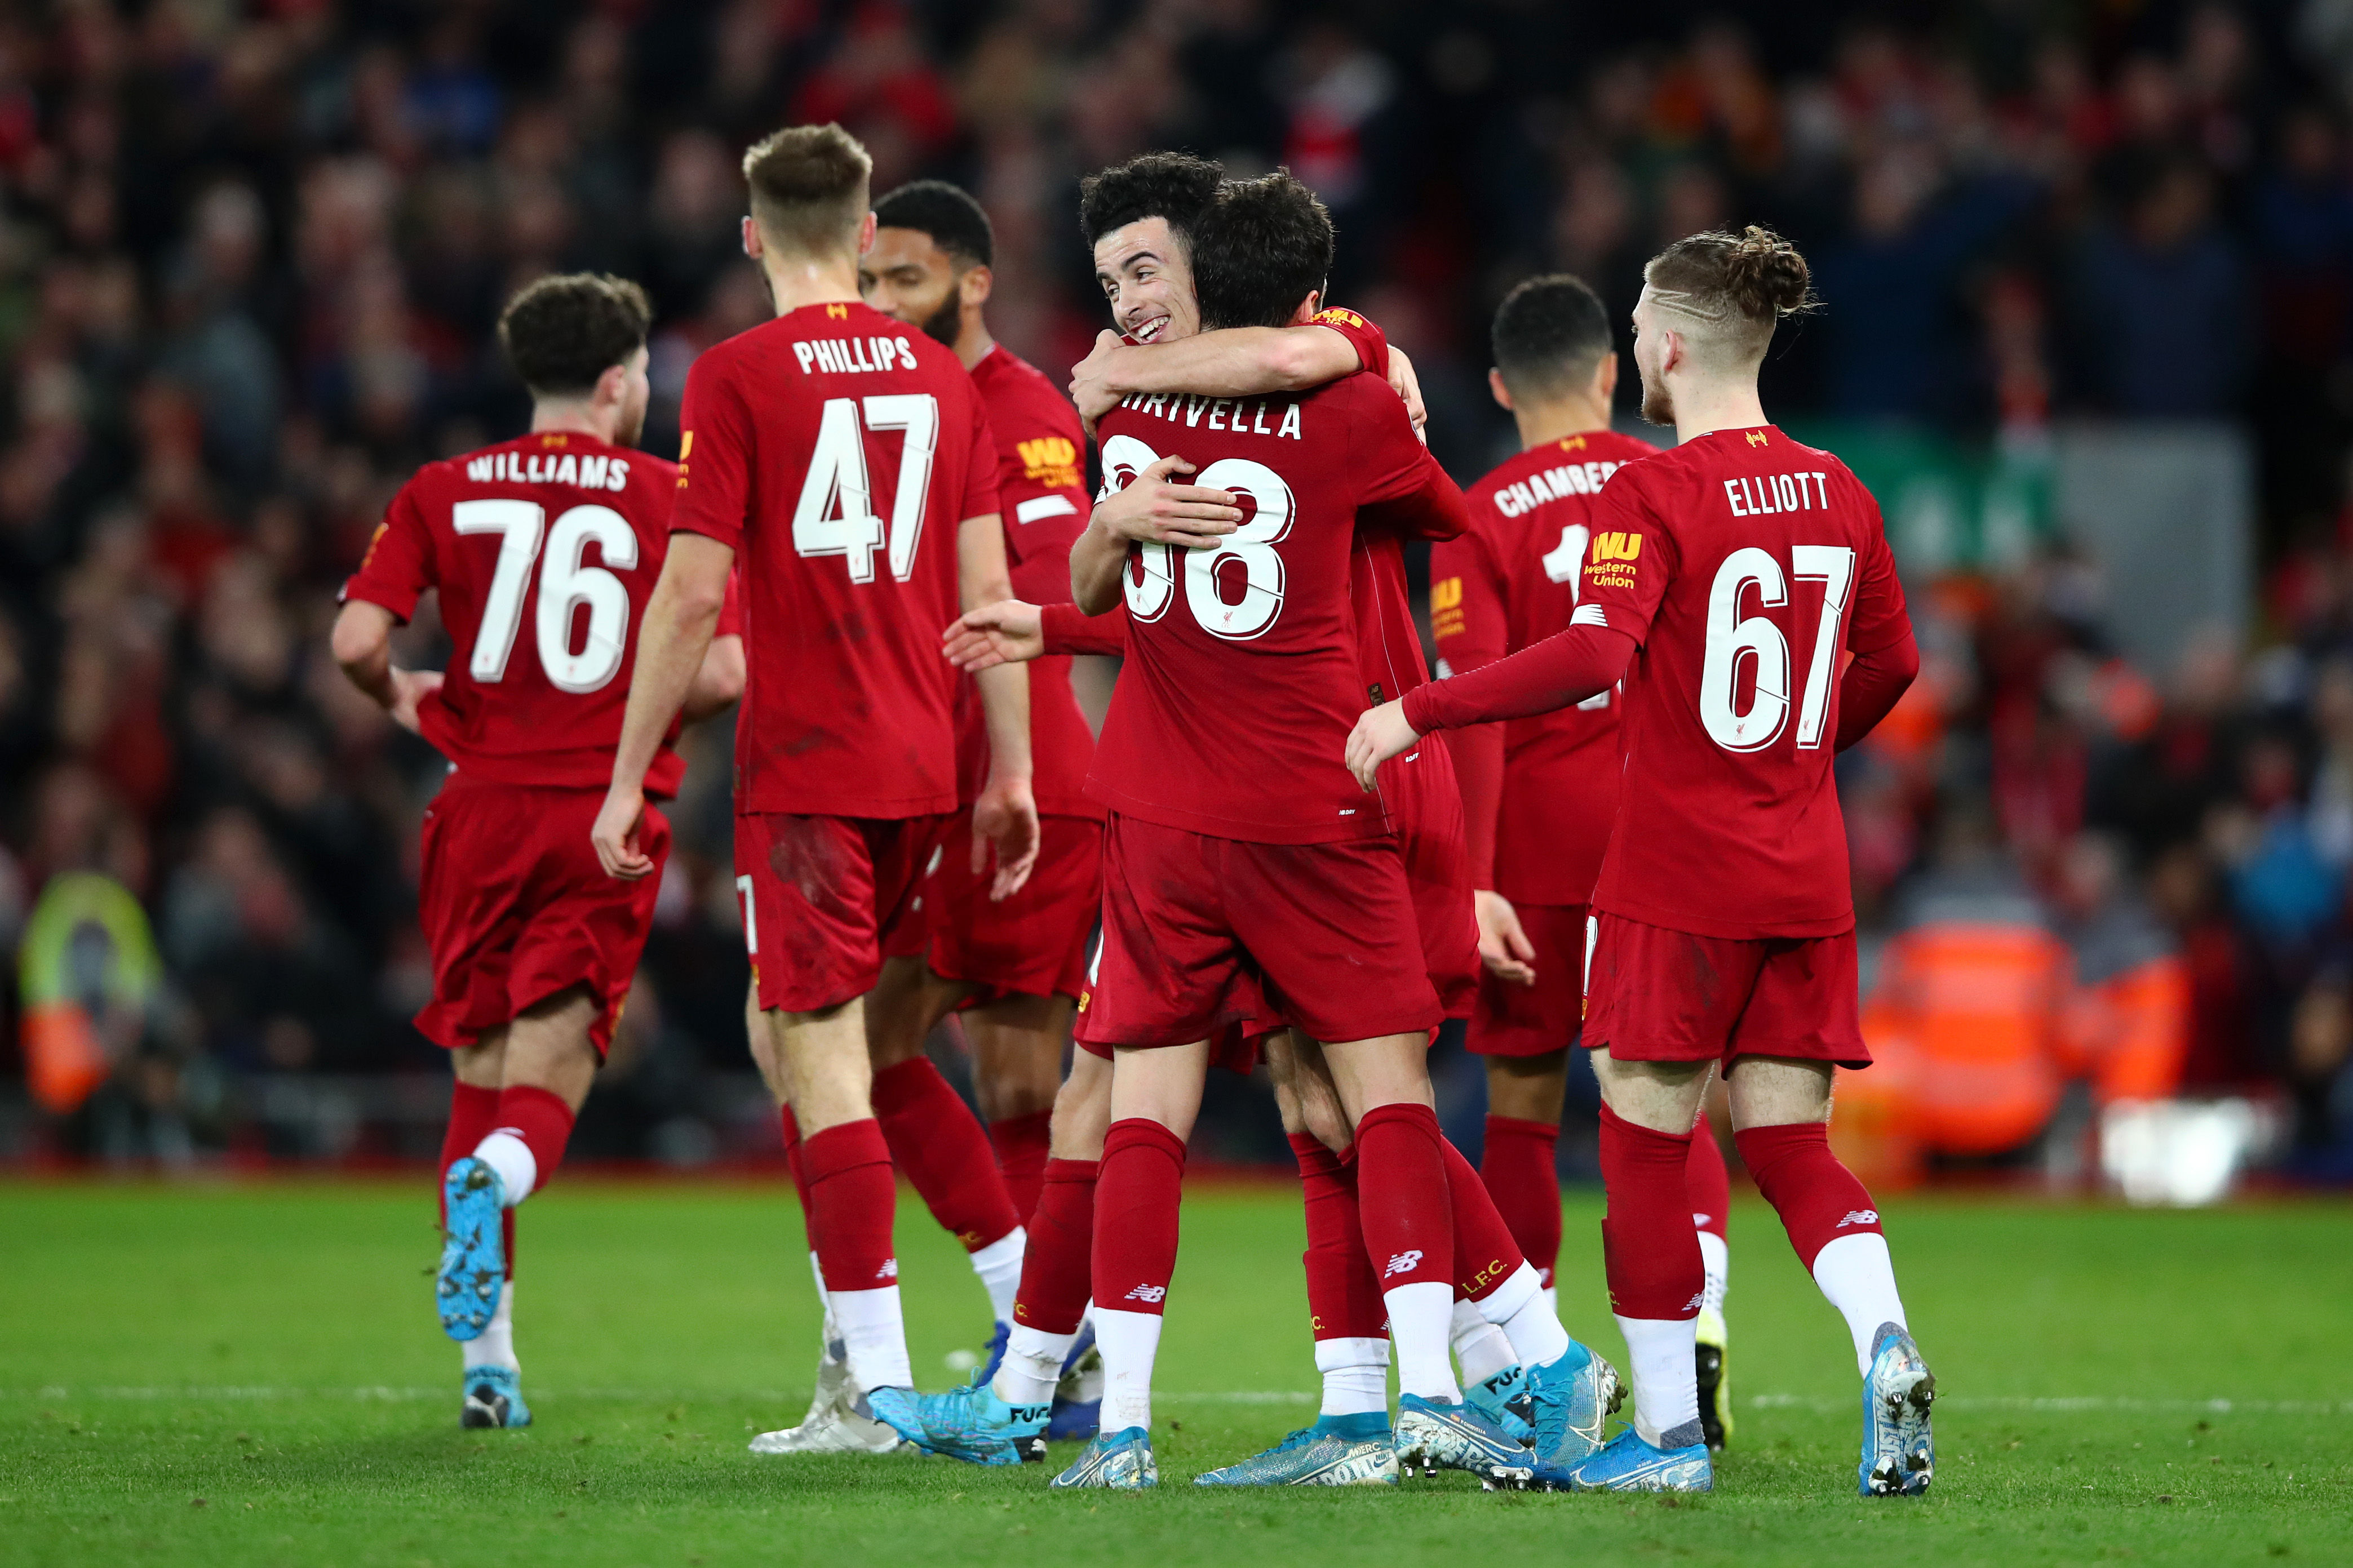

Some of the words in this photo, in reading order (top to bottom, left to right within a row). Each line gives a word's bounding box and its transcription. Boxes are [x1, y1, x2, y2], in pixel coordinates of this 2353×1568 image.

[792, 336, 918, 375] PHILLIPS
[467, 452, 630, 491] WILLIAMS
[1017, 437, 1076, 467] WU
[792, 393, 940, 585] 47
[1724, 472, 1827, 516] ELLIOTT
[1592, 531, 1642, 564] WU
[1584, 562, 1636, 575] Western
[1593, 573, 1634, 589] Union
[453, 499, 639, 694] 76
[1699, 545, 1855, 753] 67
